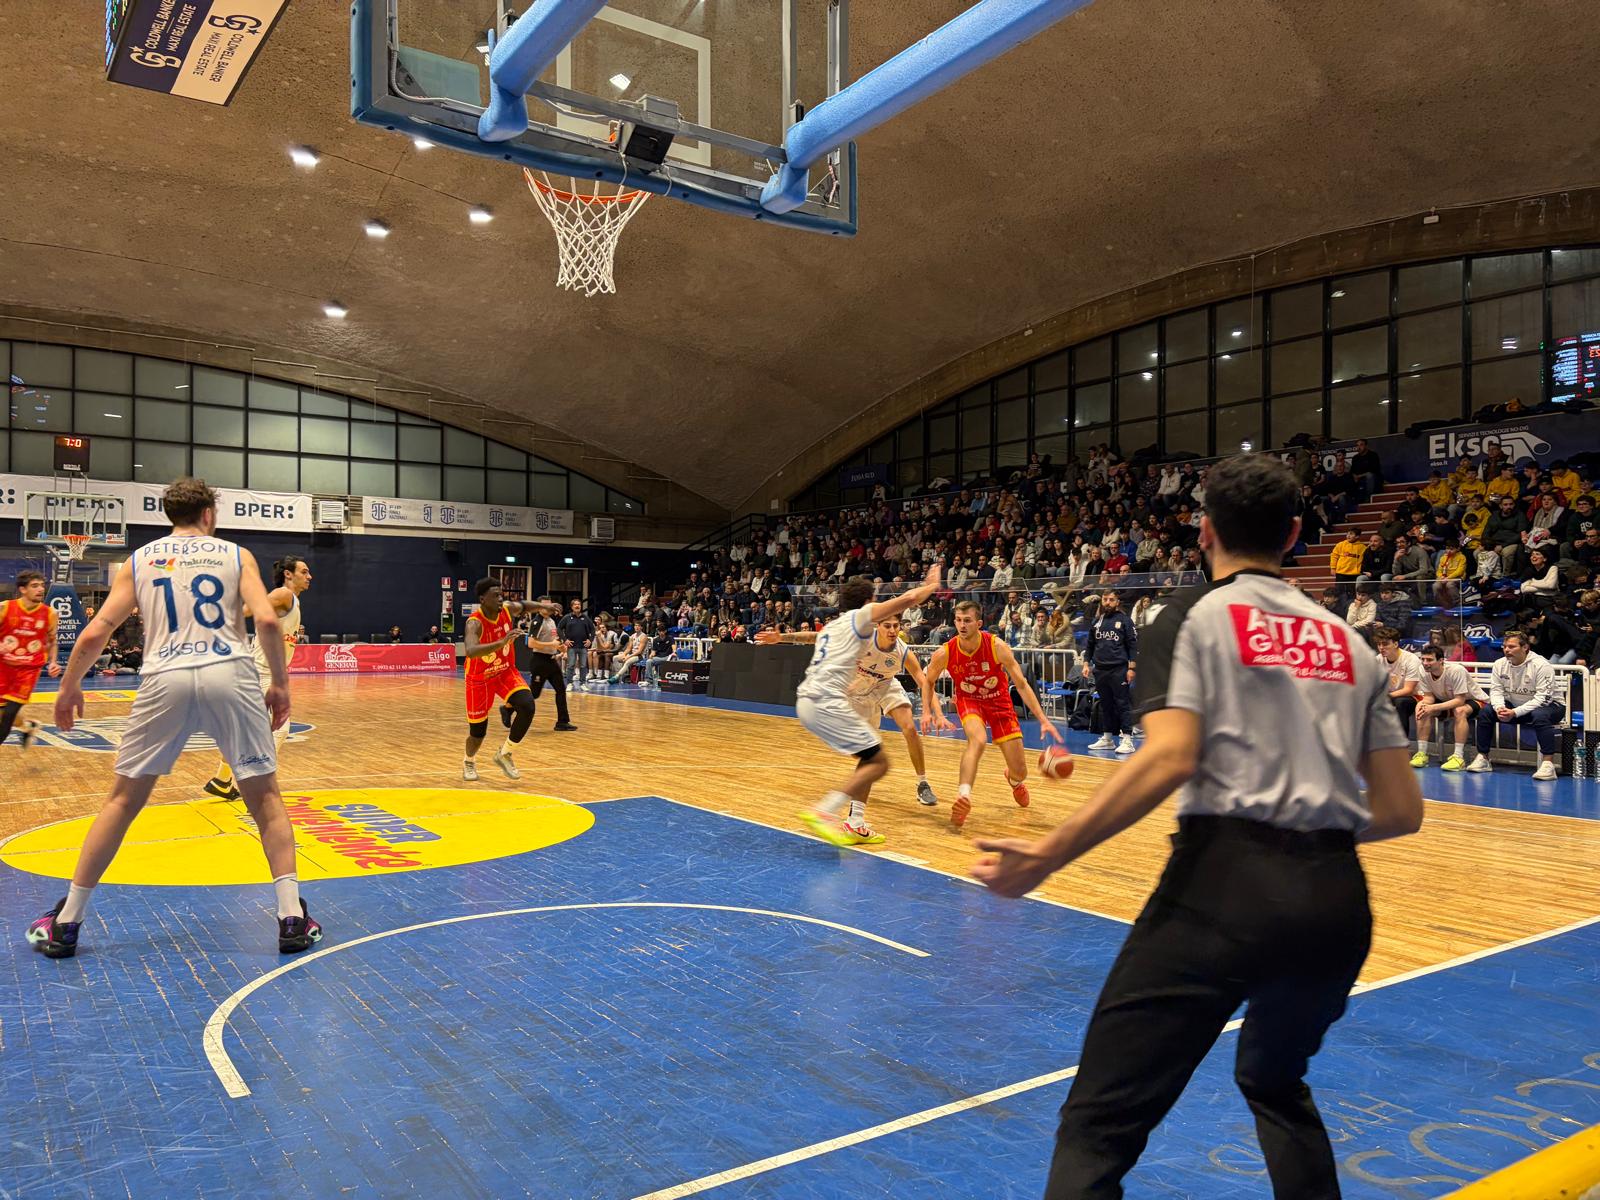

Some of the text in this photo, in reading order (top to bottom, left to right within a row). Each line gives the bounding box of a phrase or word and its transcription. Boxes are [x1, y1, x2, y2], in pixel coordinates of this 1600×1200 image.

[156, 0, 177, 20] BANKE
[177, 3, 196, 25] ESTATE
[144, 542, 228, 557] PETERSON
[152, 574, 225, 633] 18
[428, 651, 450, 661] Eligo
[1249, 633, 1345, 669] GOUP
[665, 672, 688, 680] C-HR
[323, 803, 442, 844] SUPER
